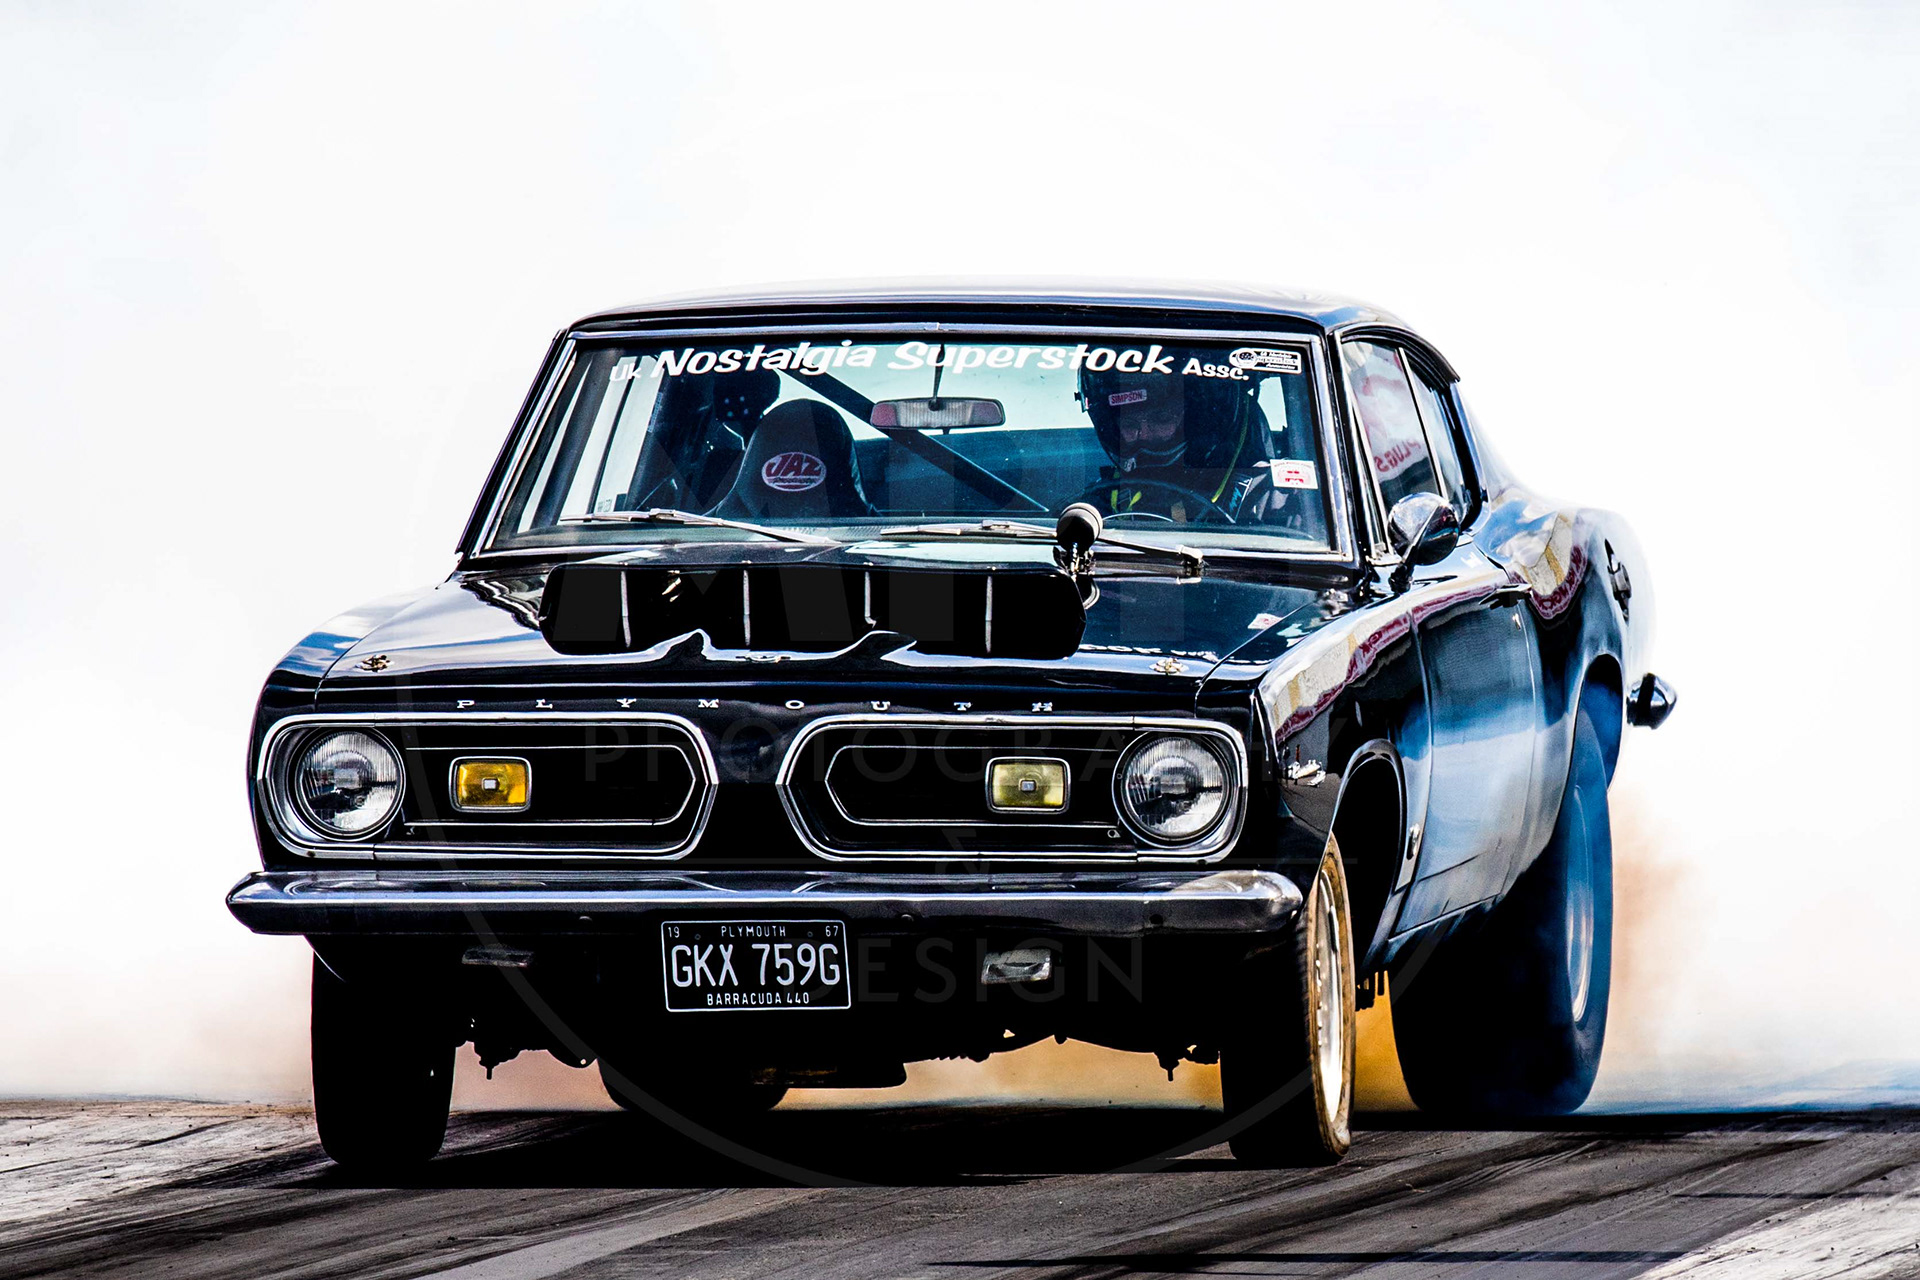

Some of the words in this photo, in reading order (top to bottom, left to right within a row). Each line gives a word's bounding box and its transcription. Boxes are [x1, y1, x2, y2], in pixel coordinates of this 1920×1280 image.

[650, 339, 876, 378] Nostalgia
[887, 341, 1175, 374] Superstock
[1182, 357, 1250, 381] Assc.
[1110, 390, 1144, 404] SIMPSON
[765, 453, 822, 477] JAZ
[457, 698, 1053, 713] PLYMOUTH
[668, 926, 680, 938] 19
[721, 926, 786, 937] PLYMOUTH
[825, 926, 838, 937] 67
[671, 944, 739, 987] GKX
[751, 943, 841, 986] 759G
[707, 992, 782, 1006] BARRACUDA
[787, 992, 810, 1004] 440
